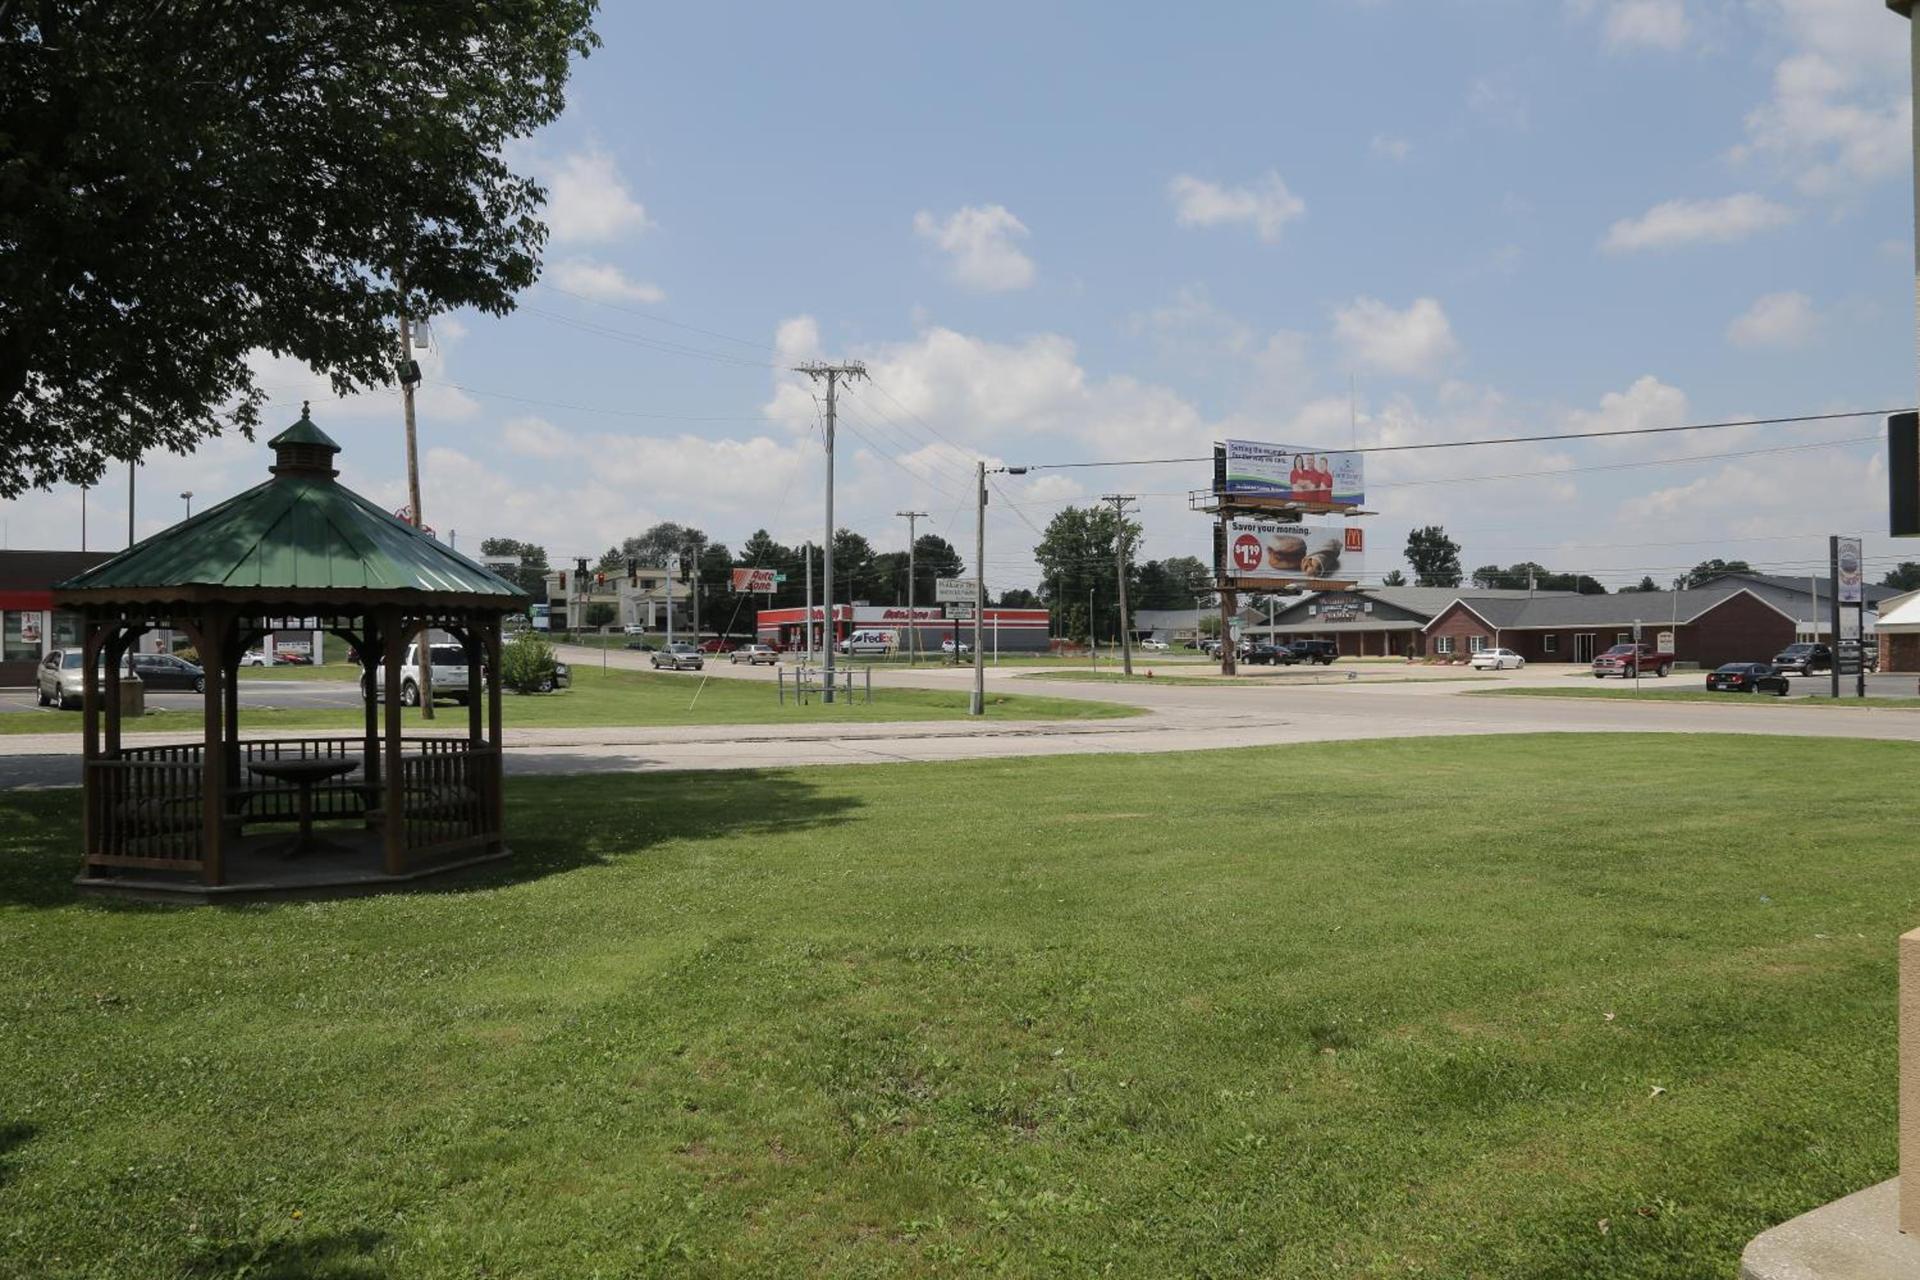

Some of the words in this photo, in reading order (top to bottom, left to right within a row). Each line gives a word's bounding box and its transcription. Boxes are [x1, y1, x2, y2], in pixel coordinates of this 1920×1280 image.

[1232, 521, 1256, 531] Savor
[1257, 523, 1275, 534] your
[1276, 525, 1312, 536] morning.
[751, 570, 774, 581] Auto
[863, 632, 894, 643] FedEx
